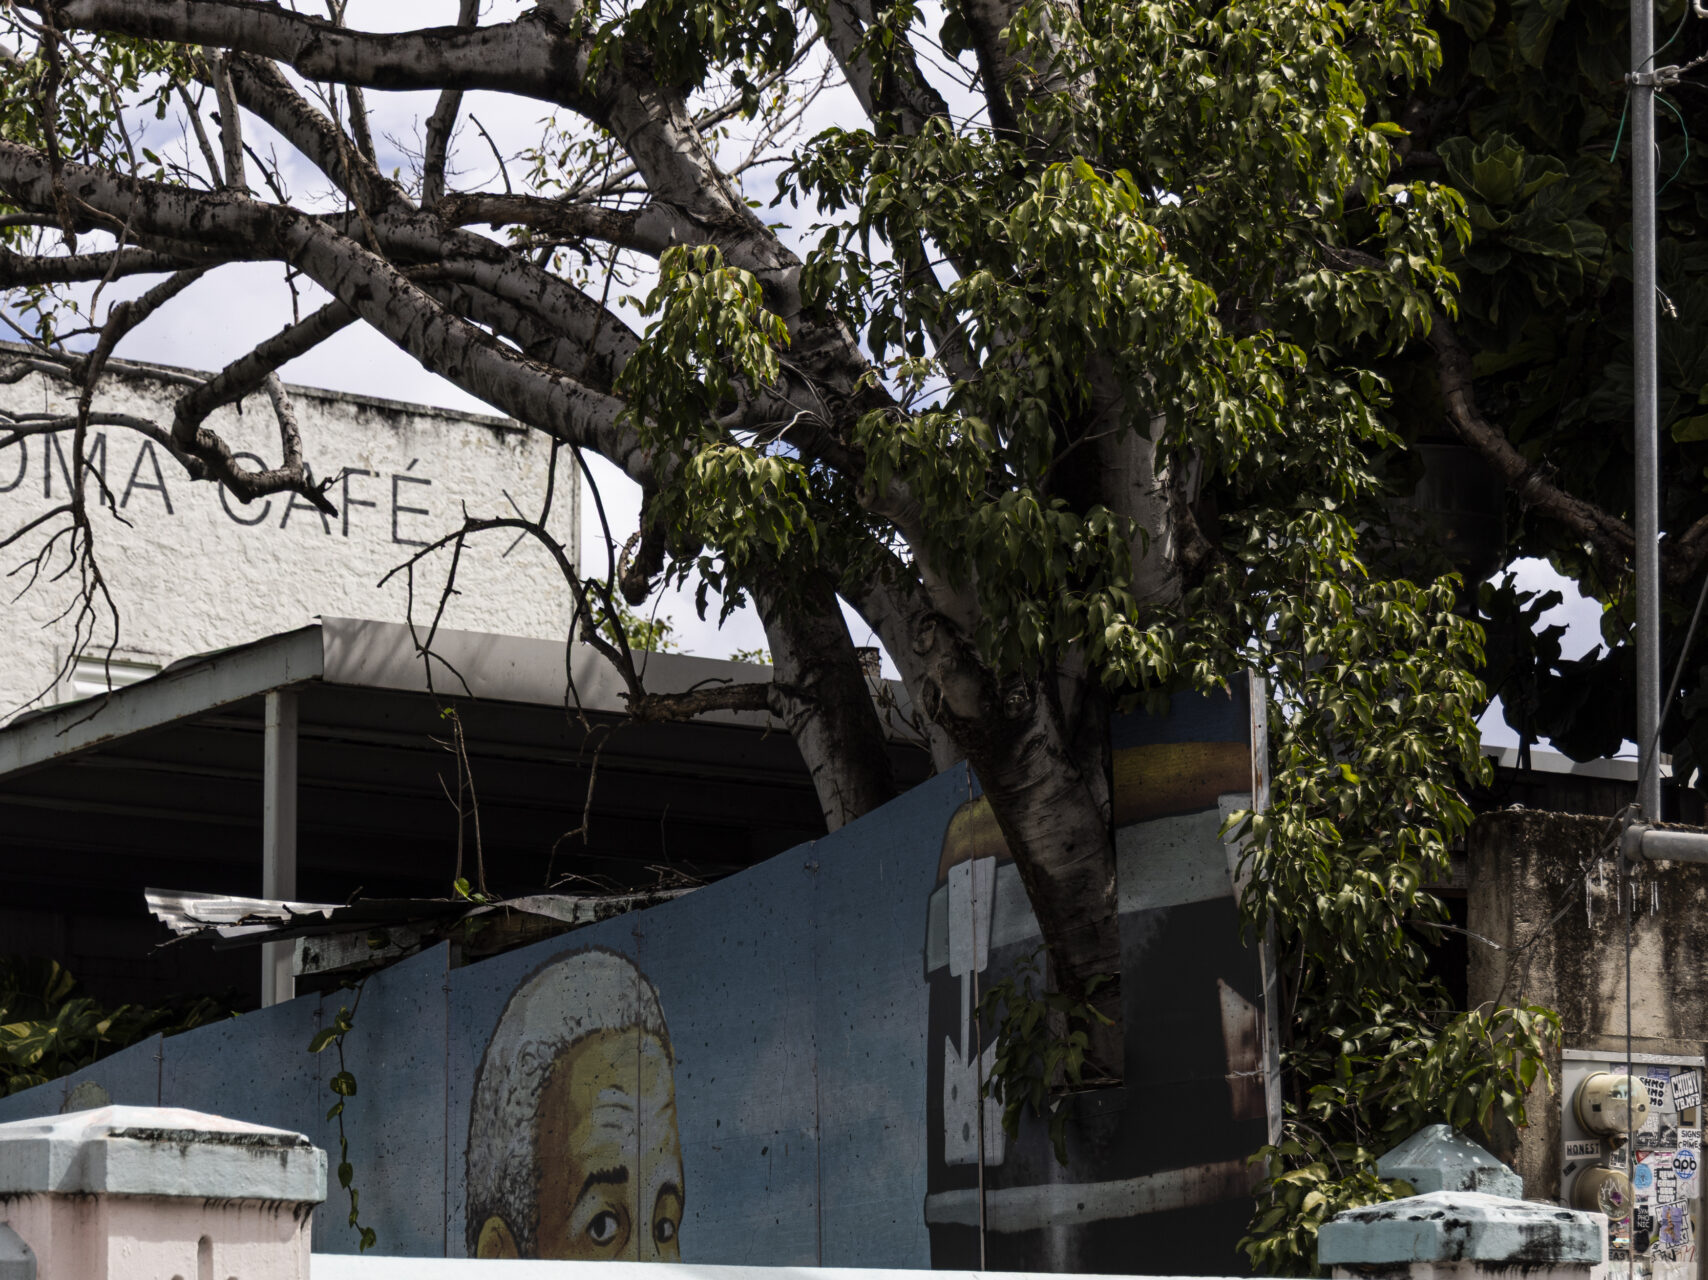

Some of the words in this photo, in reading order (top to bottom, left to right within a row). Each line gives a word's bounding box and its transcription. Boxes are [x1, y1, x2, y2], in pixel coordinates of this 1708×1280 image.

[218, 451, 433, 547] CAFÉ
[1681, 1129, 1701, 1139] SIGNS
[1567, 1143, 1600, 1156] HONEST
